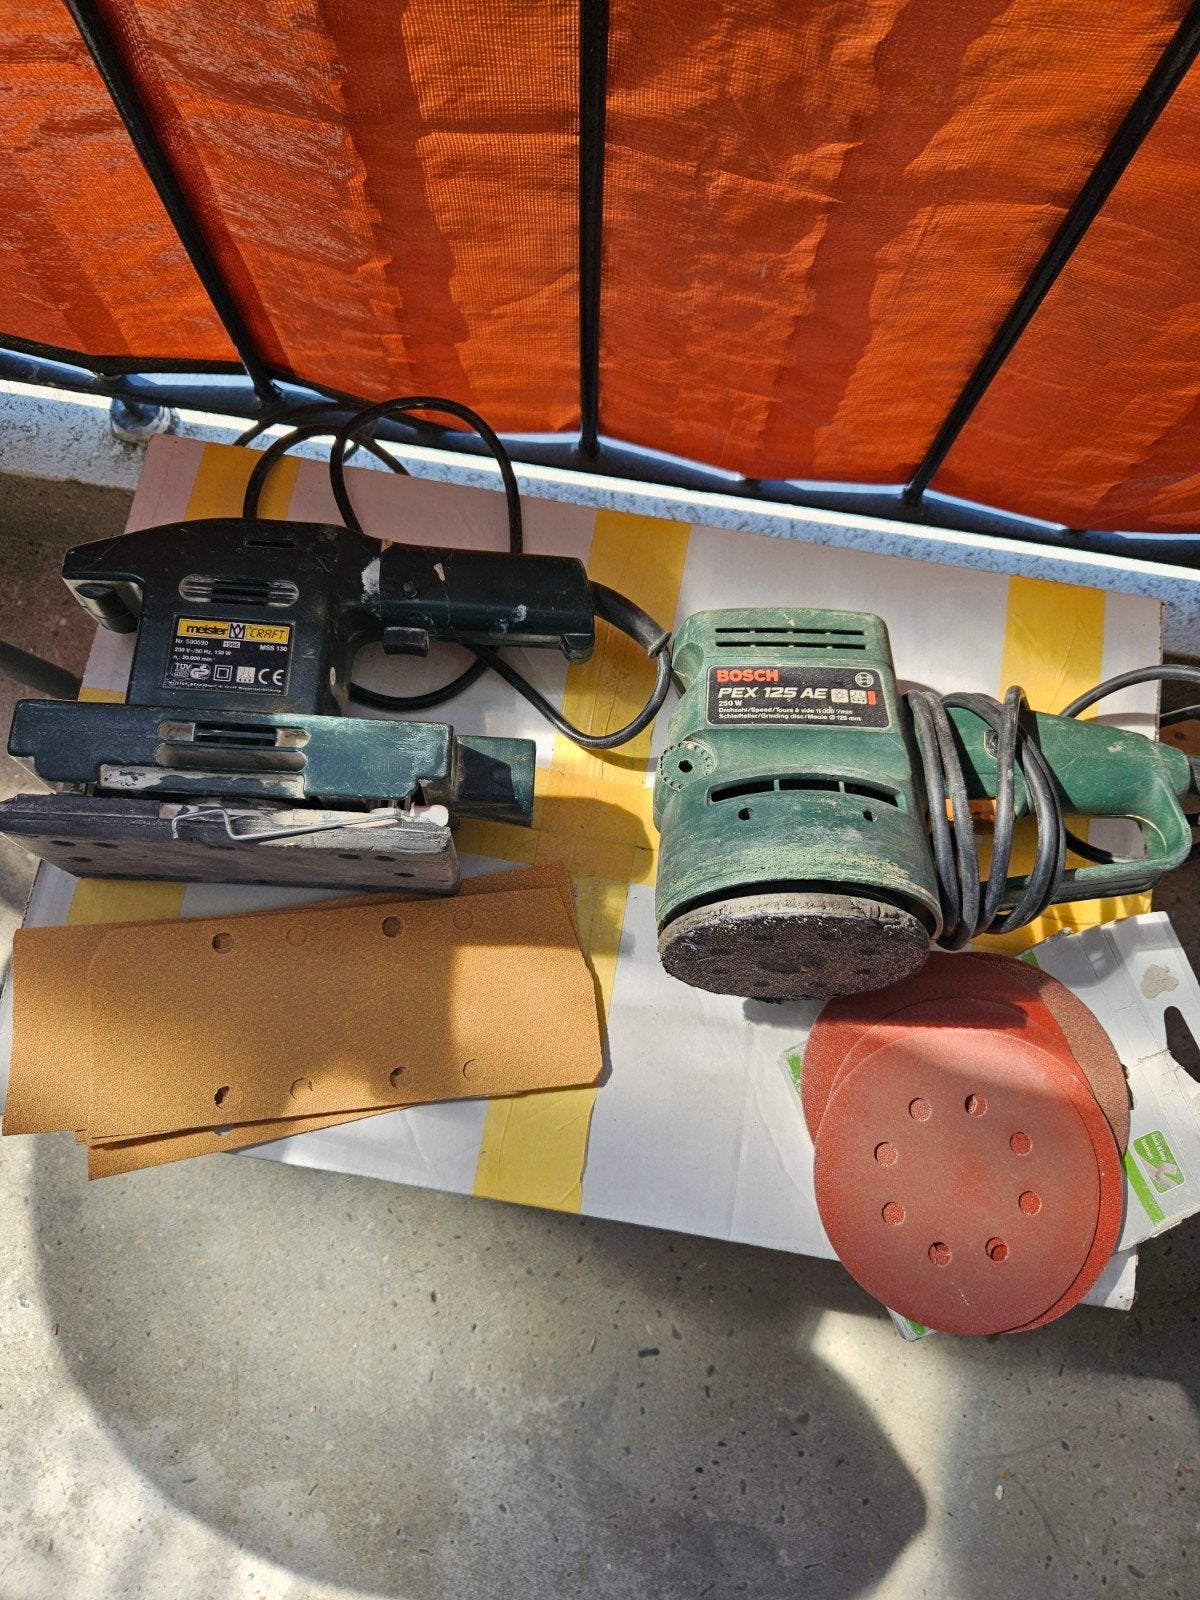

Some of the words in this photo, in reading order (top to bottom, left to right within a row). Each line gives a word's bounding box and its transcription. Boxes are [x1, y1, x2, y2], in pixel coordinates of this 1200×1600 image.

[186, 624, 228, 636] meister
[249, 628, 286, 640] CRAFT
[258, 669, 285, 686] CE
[716, 669, 779, 683] BOSCH
[718, 687, 757, 699] PEX
[763, 687, 799, 699] 125
[800, 688, 828, 699] AE
